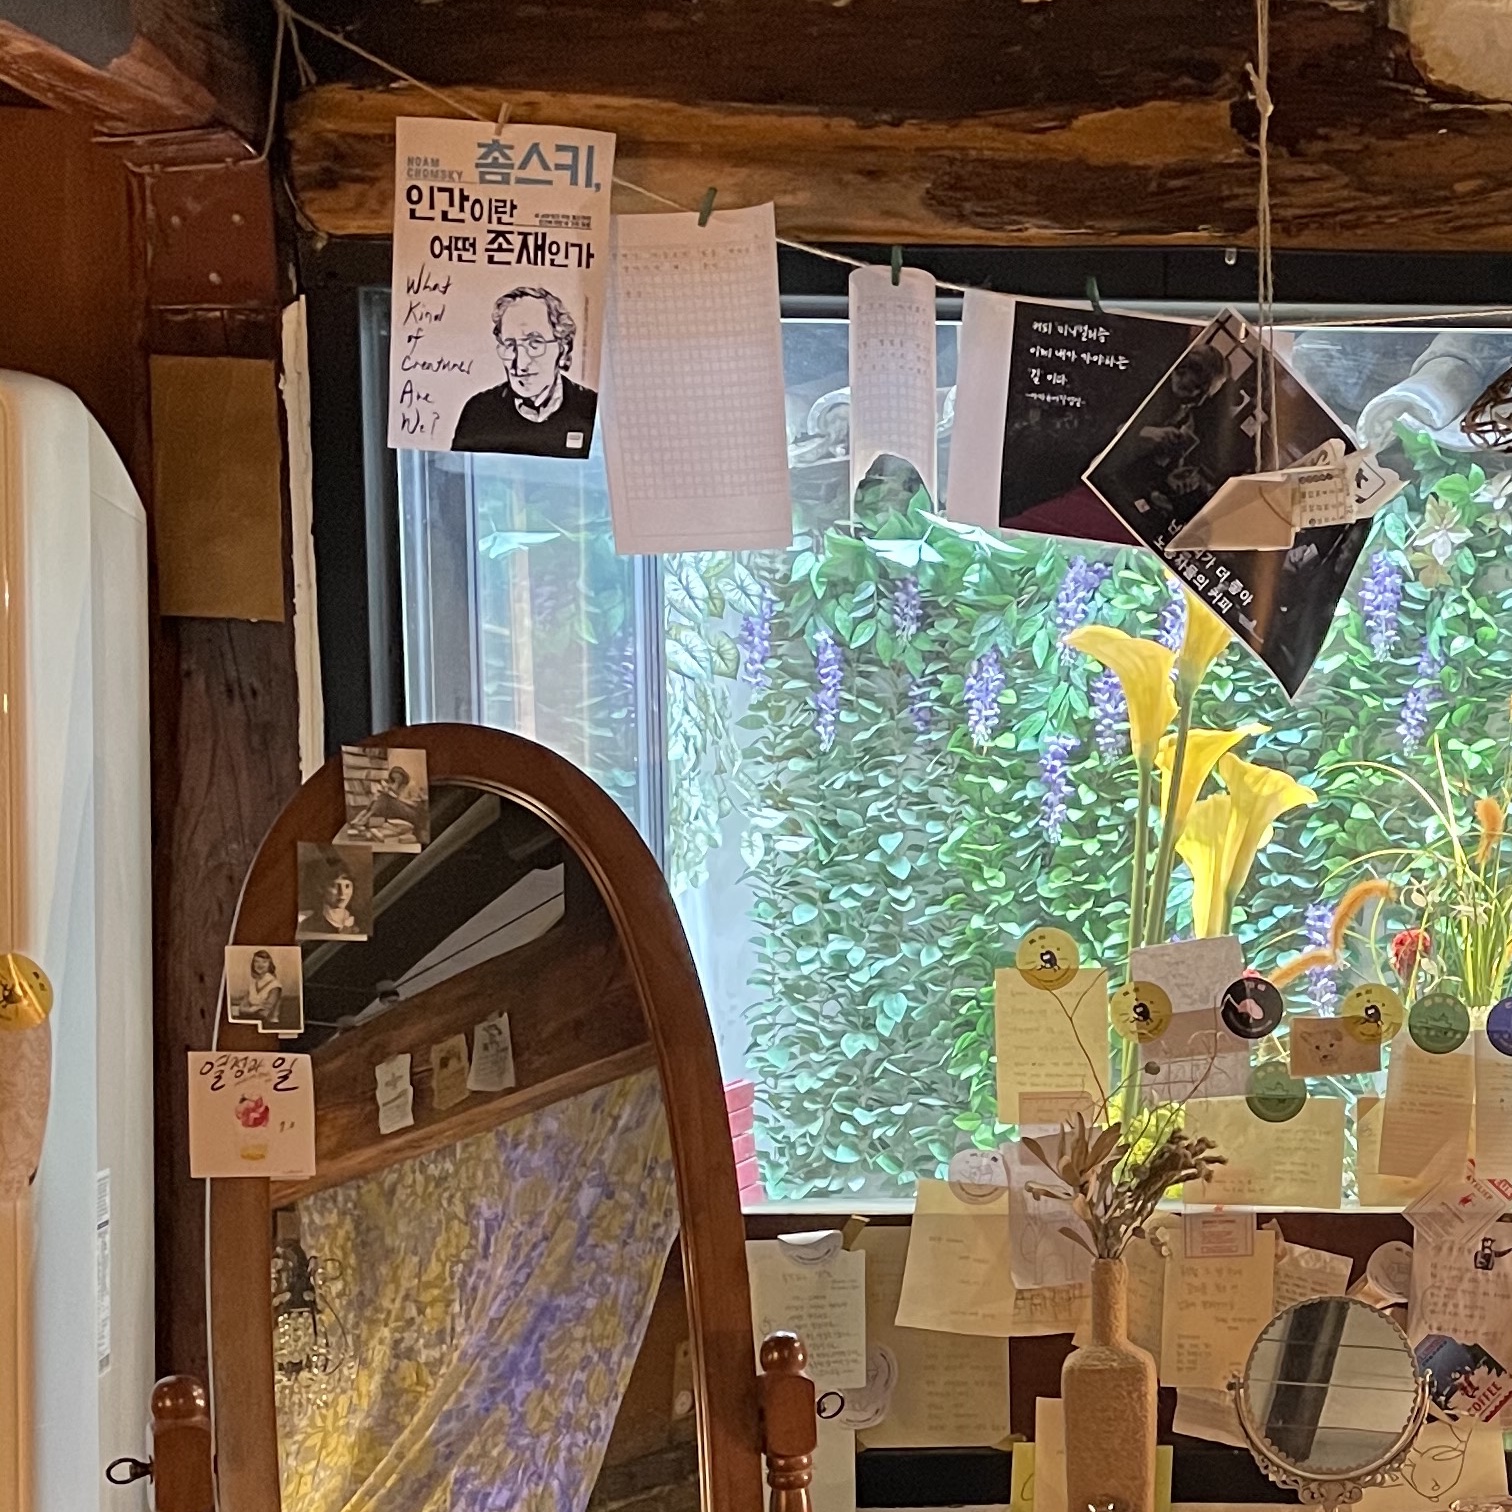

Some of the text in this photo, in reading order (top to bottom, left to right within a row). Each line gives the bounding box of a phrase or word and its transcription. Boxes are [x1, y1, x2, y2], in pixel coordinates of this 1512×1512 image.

[406, 168, 463, 182] CHOMSKY
[407, 156, 440, 168] NOAM
[475, 139, 602, 193] 촘스키,
[406, 184, 517, 226] 인간이란
[430, 235, 477, 263] 어떤
[484, 229, 594, 269] 존재인가
[406, 263, 453, 295] What
[403, 301, 446, 326] Kind
[407, 327, 425, 355] of
[401, 355, 473, 375] Creatures
[400, 379, 434, 408] Are
[401, 408, 440, 440] We?
[1215, 566, 1231, 583] 더
[1207, 588, 1233, 614] 커피
